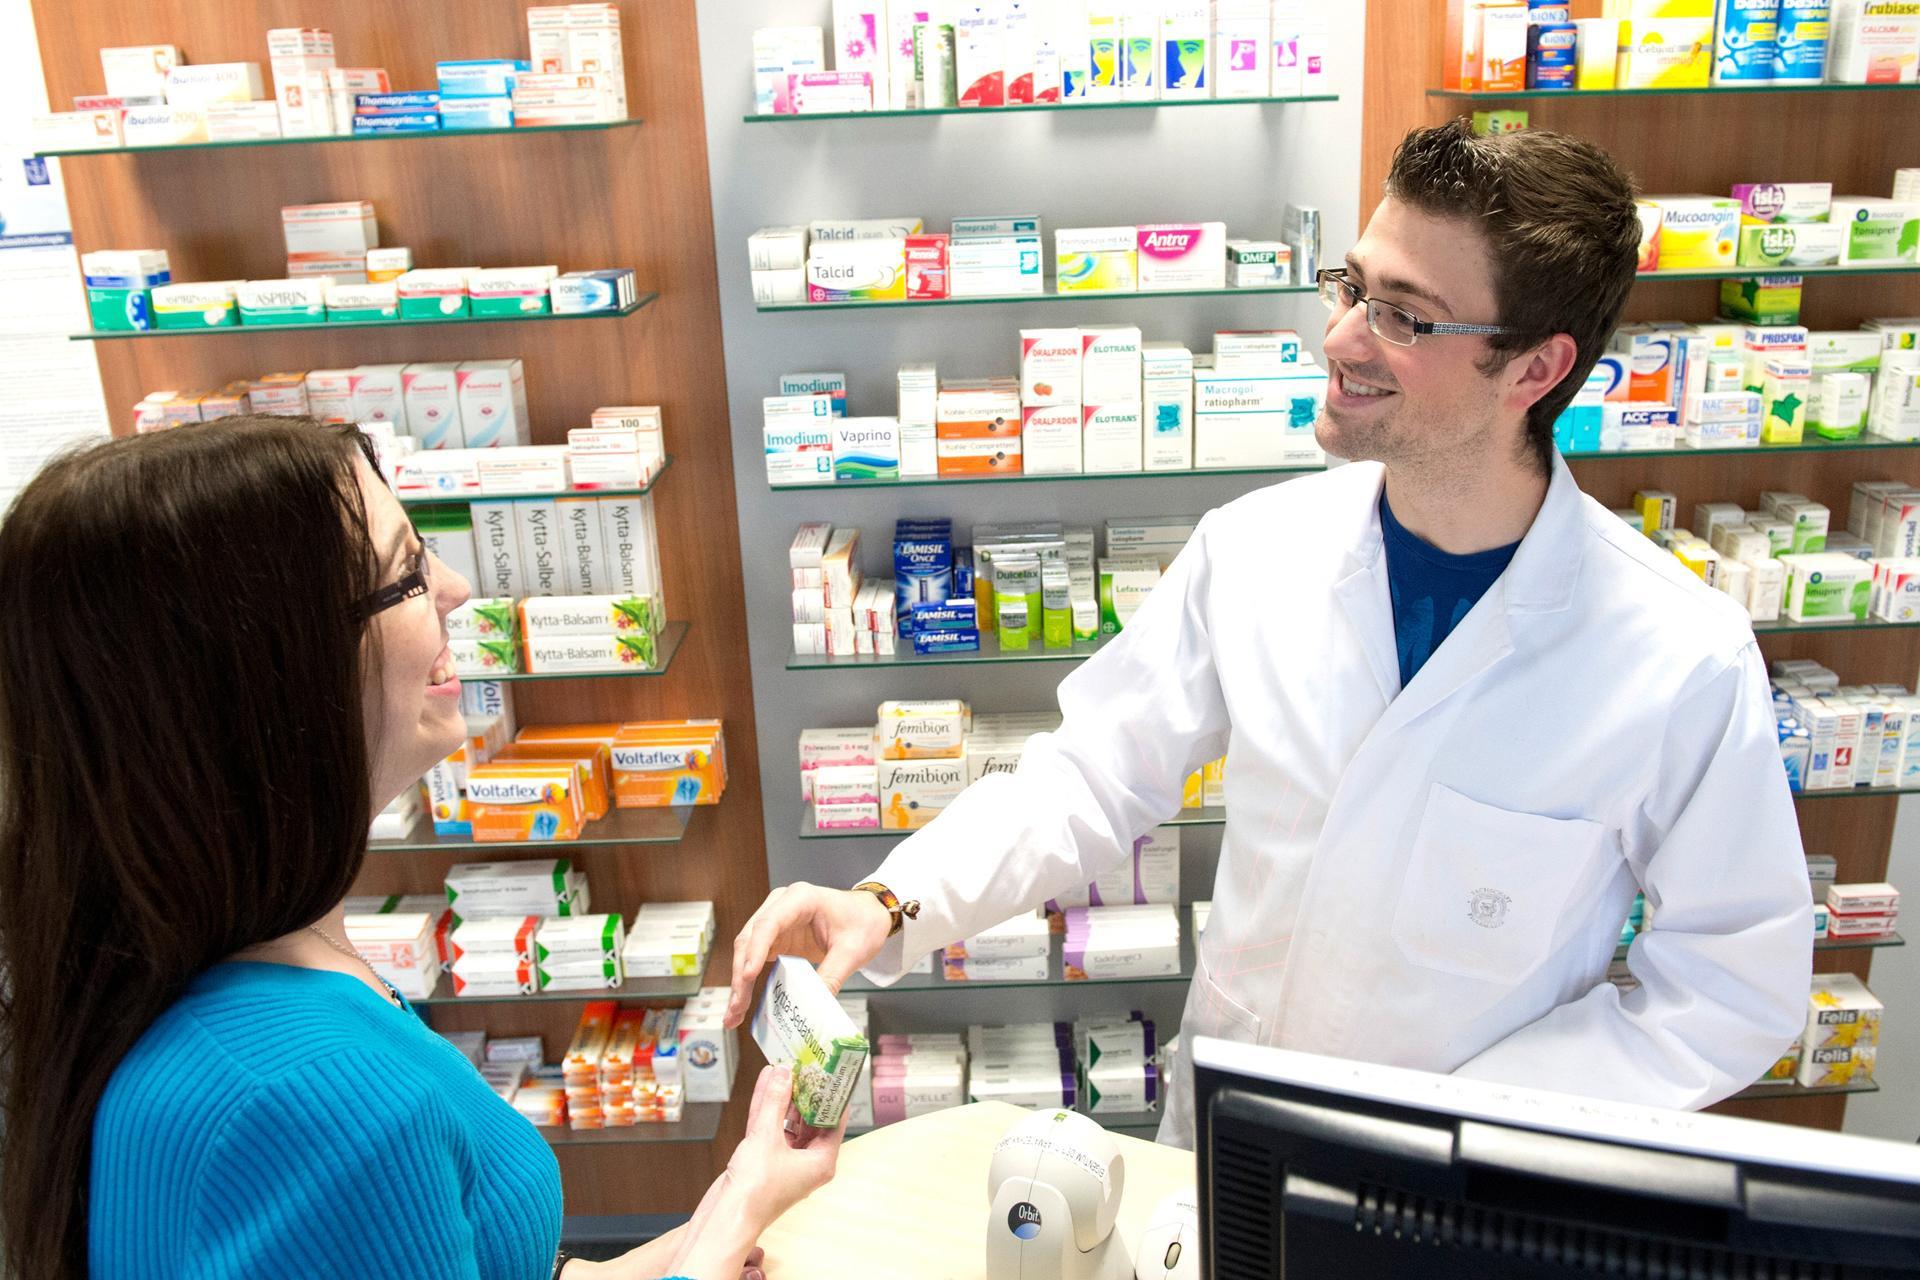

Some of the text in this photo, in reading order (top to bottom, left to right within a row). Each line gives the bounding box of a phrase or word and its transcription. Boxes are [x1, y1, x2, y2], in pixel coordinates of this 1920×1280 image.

[1863, 0, 1920, 15] frubiase
[1664, 211, 1735, 225] Mucoangin
[816, 228, 855, 240] Talcid
[1144, 231, 1190, 247] Antra
[1763, 228, 1795, 247] isla
[1240, 253, 1274, 263] OMEP
[814, 266, 854, 279] Talcid
[255, 290, 307, 306] ASPIRIN
[1762, 332, 1805, 344] PROSPAN
[1032, 347, 1078, 357] ORALPADON
[1093, 344, 1137, 353] ELOTRANS
[783, 379, 842, 393] Imodium
[1204, 384, 1254, 395] Macrogol
[1703, 399, 1722, 410] NAC
[620, 418, 640, 428] 100
[1032, 416, 1078, 426] ORALPADON
[1095, 414, 1138, 424] ELOTRANS
[1623, 412, 1648, 422] ACC
[840, 429, 892, 443] Vaprino
[1702, 423, 1721, 435] NAC
[767, 431, 829, 446] Imodium
[485, 509, 513, 591] Kytta-Salbe
[527, 508, 556, 589] Kytta-Salbe
[569, 507, 593, 593] Kytta-Balsam
[611, 504, 635, 588] Kytta-Balsam
[901, 543, 945, 554] LAMISIL
[996, 569, 1039, 581] Dulcolax
[1115, 585, 1140, 593] Lefax
[530, 613, 602, 627] Kytta-Balsam
[917, 610, 958, 620] LAMISIL
[919, 633, 960, 643] LAMISIL
[535, 648, 606, 662] Kytta-Balsam
[890, 719, 951, 739] femibion
[616, 751, 681, 765] Voltaflex
[883, 766, 961, 790] femibion
[470, 783, 538, 798] Voltaflex
[773, 979, 827, 1065] Kytta-Sedativum
[1821, 1011, 1857, 1025] Felis
[1815, 1050, 1850, 1063] Felis
[818, 1065, 848, 1123] Kytta-Sedativum
[1018, 1204, 1040, 1221] Orbit
